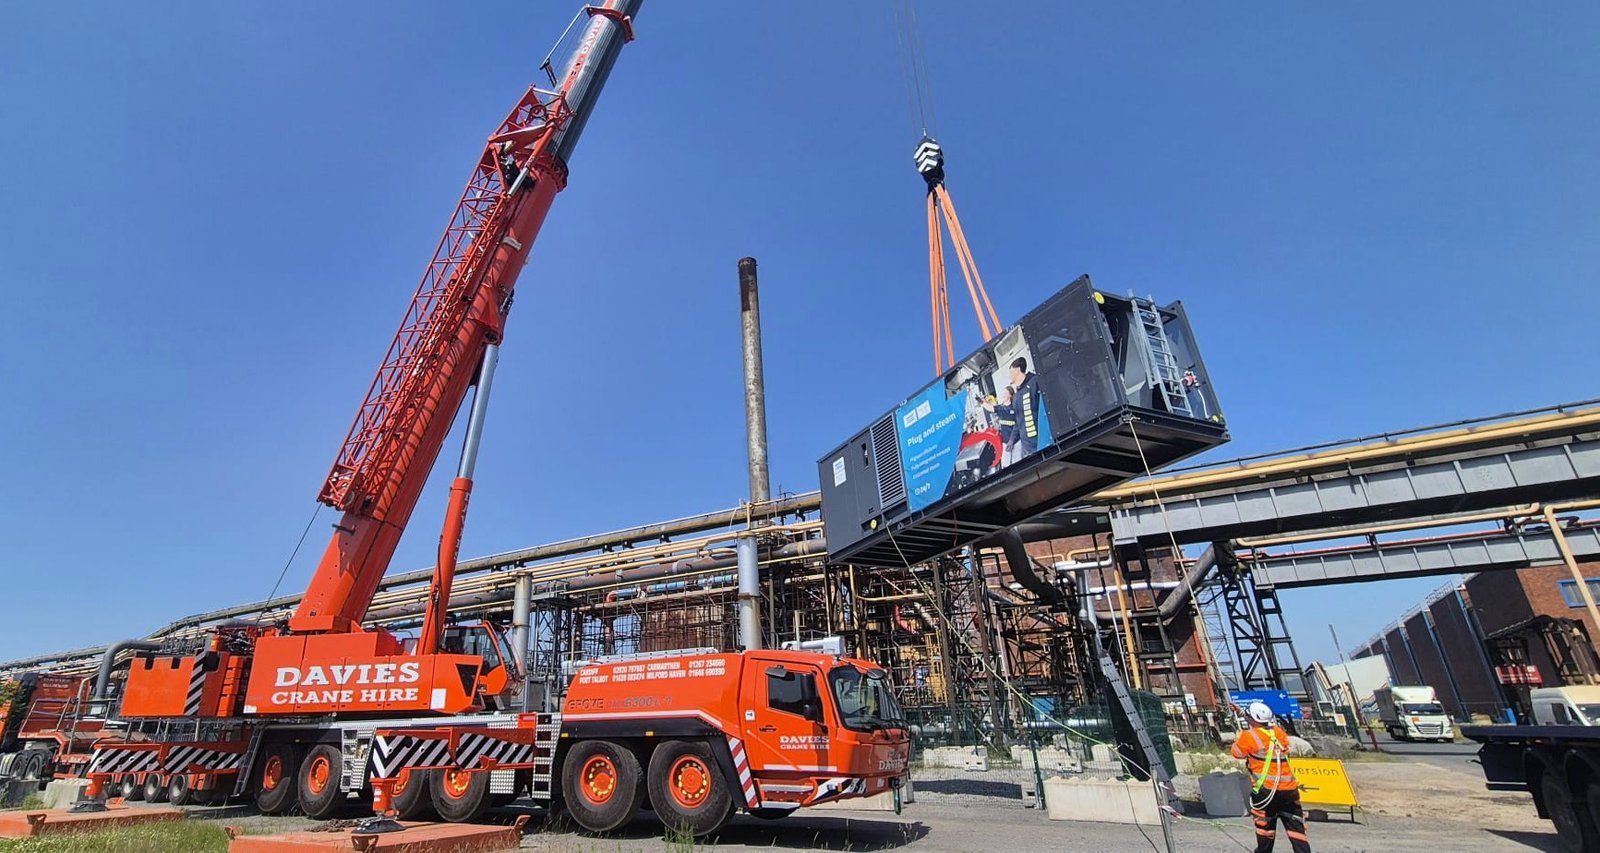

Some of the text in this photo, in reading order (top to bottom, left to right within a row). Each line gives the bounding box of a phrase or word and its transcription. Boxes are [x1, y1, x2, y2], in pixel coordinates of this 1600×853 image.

[907, 412, 957, 447] Plug and steam
[275, 662, 420, 687] DAVIES
[579, 676, 591, 685] PORT
[646, 670, 668, 680] MILFORD
[668, 670, 686, 679] HAVEN
[580, 667, 599, 676] CARDIFF
[271, 687, 419, 705] CRANE HIRE
[780, 735, 829, 743] DAVIES
